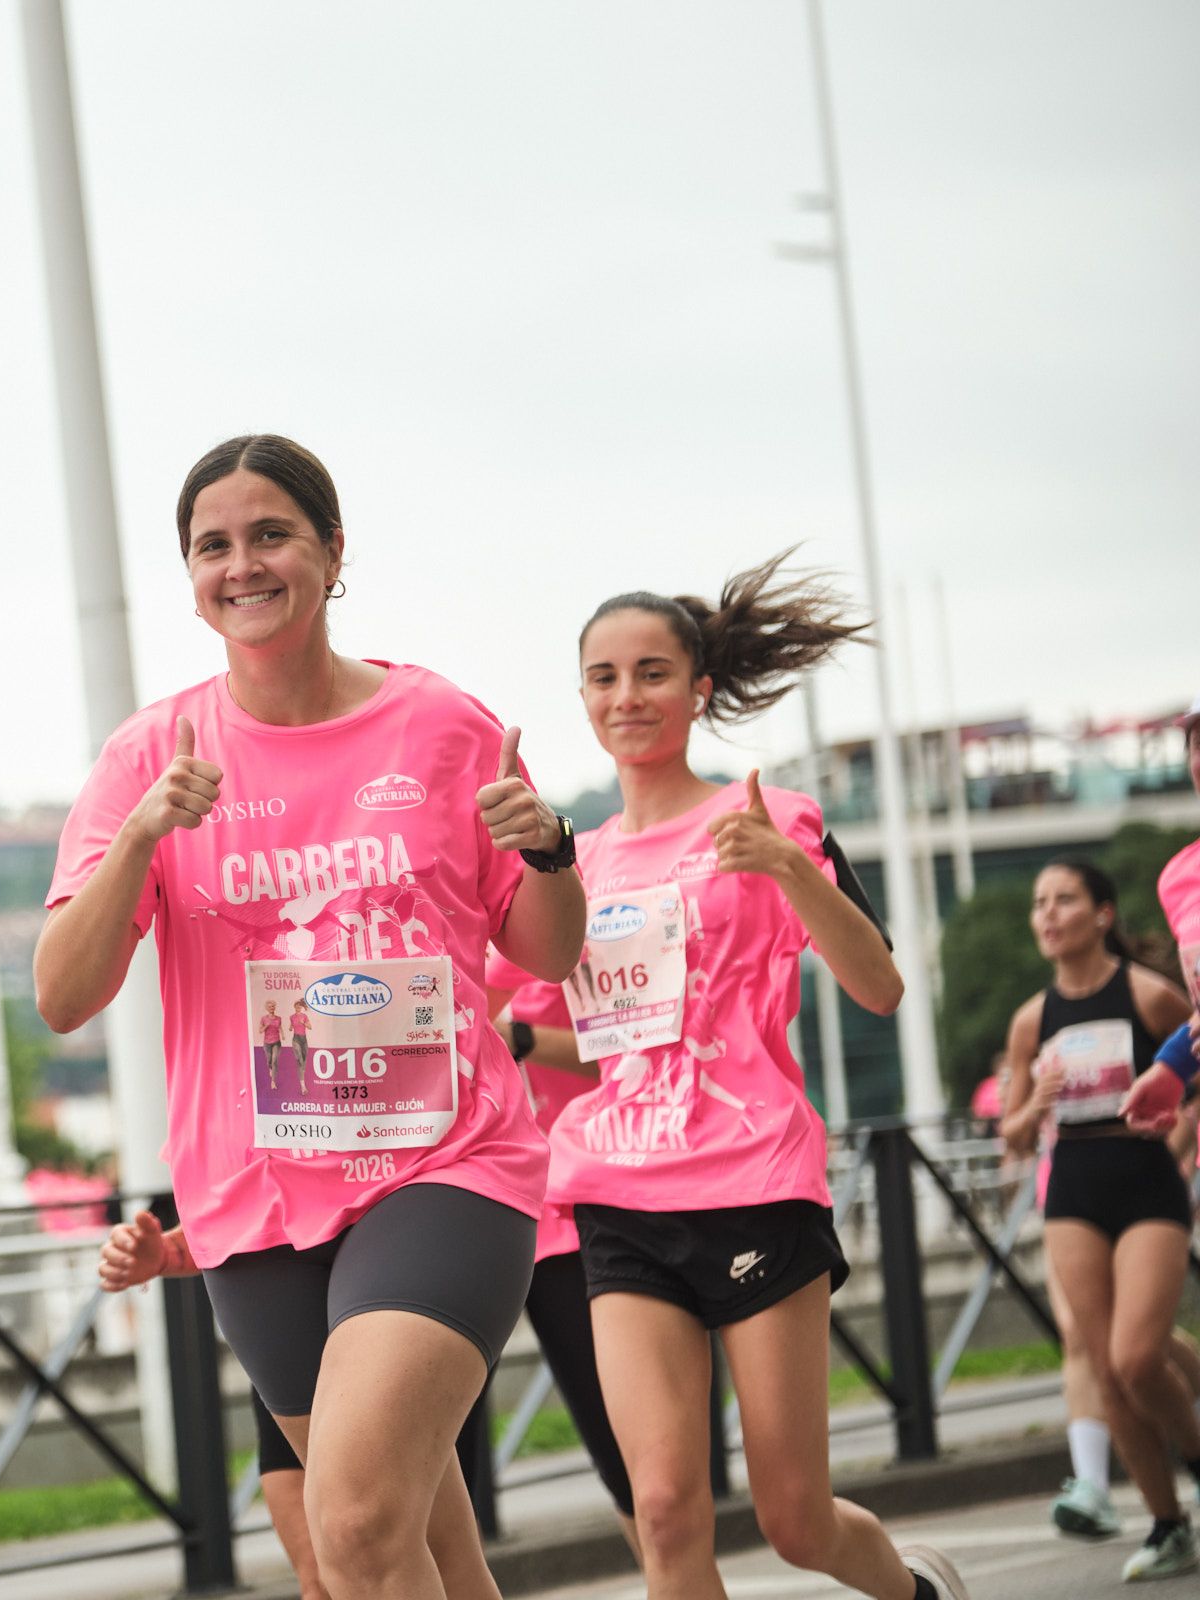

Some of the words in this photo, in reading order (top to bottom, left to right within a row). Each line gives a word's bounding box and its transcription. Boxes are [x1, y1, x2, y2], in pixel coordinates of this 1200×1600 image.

[361, 790, 423, 806] ASTURIANA
[220, 833, 416, 905] CARRERA
[274, 971, 301, 979] DORSAL
[597, 963, 649, 995] 016
[265, 979, 302, 990] SUMA
[311, 988, 386, 1005] ASTURIANA
[312, 1048, 387, 1080] 016
[391, 1047, 447, 1058] CORREDORA
[332, 1086, 368, 1099] 1373
[281, 1101, 321, 1113] CARRERA
[323, 1101, 335, 1113] DE
[338, 1102, 350, 1113] LA
[353, 1101, 386, 1113] MUJER
[396, 1098, 424, 1111] GIJÓN
[275, 1123, 332, 1139] OYSHO
[373, 1125, 434, 1138] Santander
[584, 1105, 689, 1153] MUJER
[341, 1153, 396, 1183] 2026
